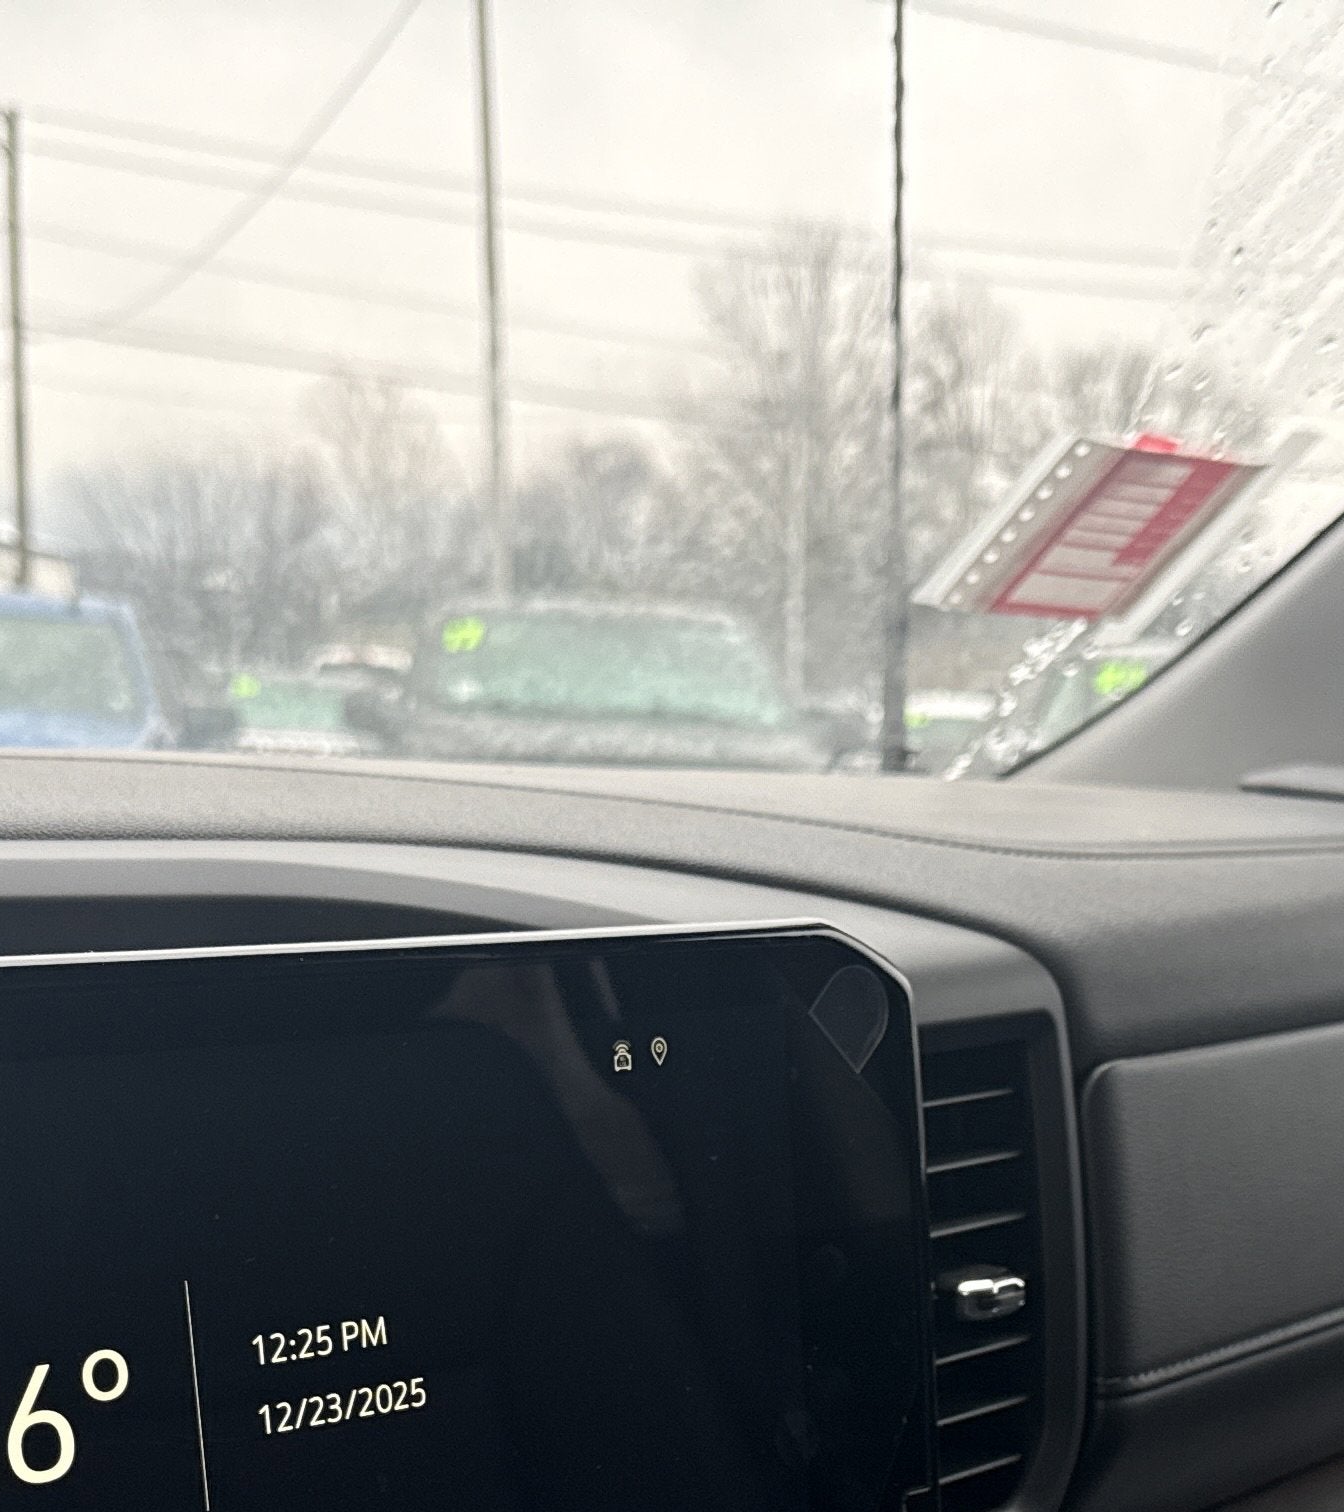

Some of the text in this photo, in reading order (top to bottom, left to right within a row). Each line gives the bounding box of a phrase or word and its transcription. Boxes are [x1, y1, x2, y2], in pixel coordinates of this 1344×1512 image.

[252, 1315, 388, 1366] 12:25 PM
[258, 1377, 427, 1435] 12/23/2025
